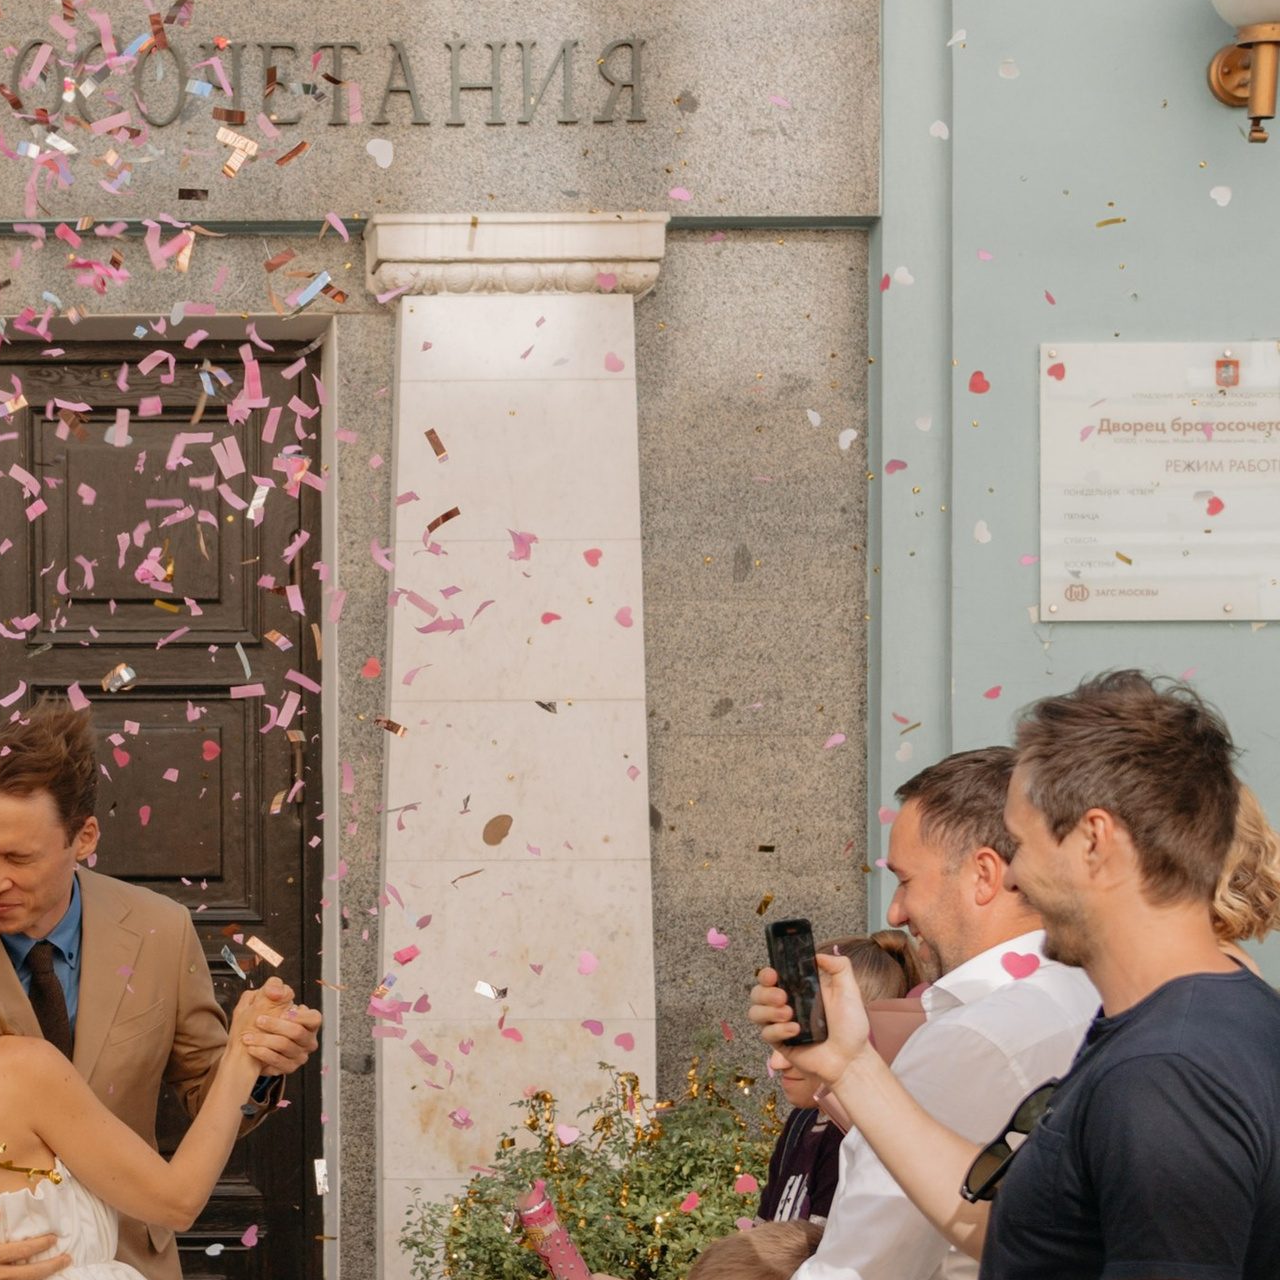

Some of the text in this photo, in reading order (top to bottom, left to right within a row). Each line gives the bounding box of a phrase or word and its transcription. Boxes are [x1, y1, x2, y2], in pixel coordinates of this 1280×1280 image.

[1097, 418, 1166, 436] Дворец
[1165, 458, 1280, 472] РЕЖИМ РАБОТ
[1095, 588, 1159, 597] ЗАГС МОСКВЫ
